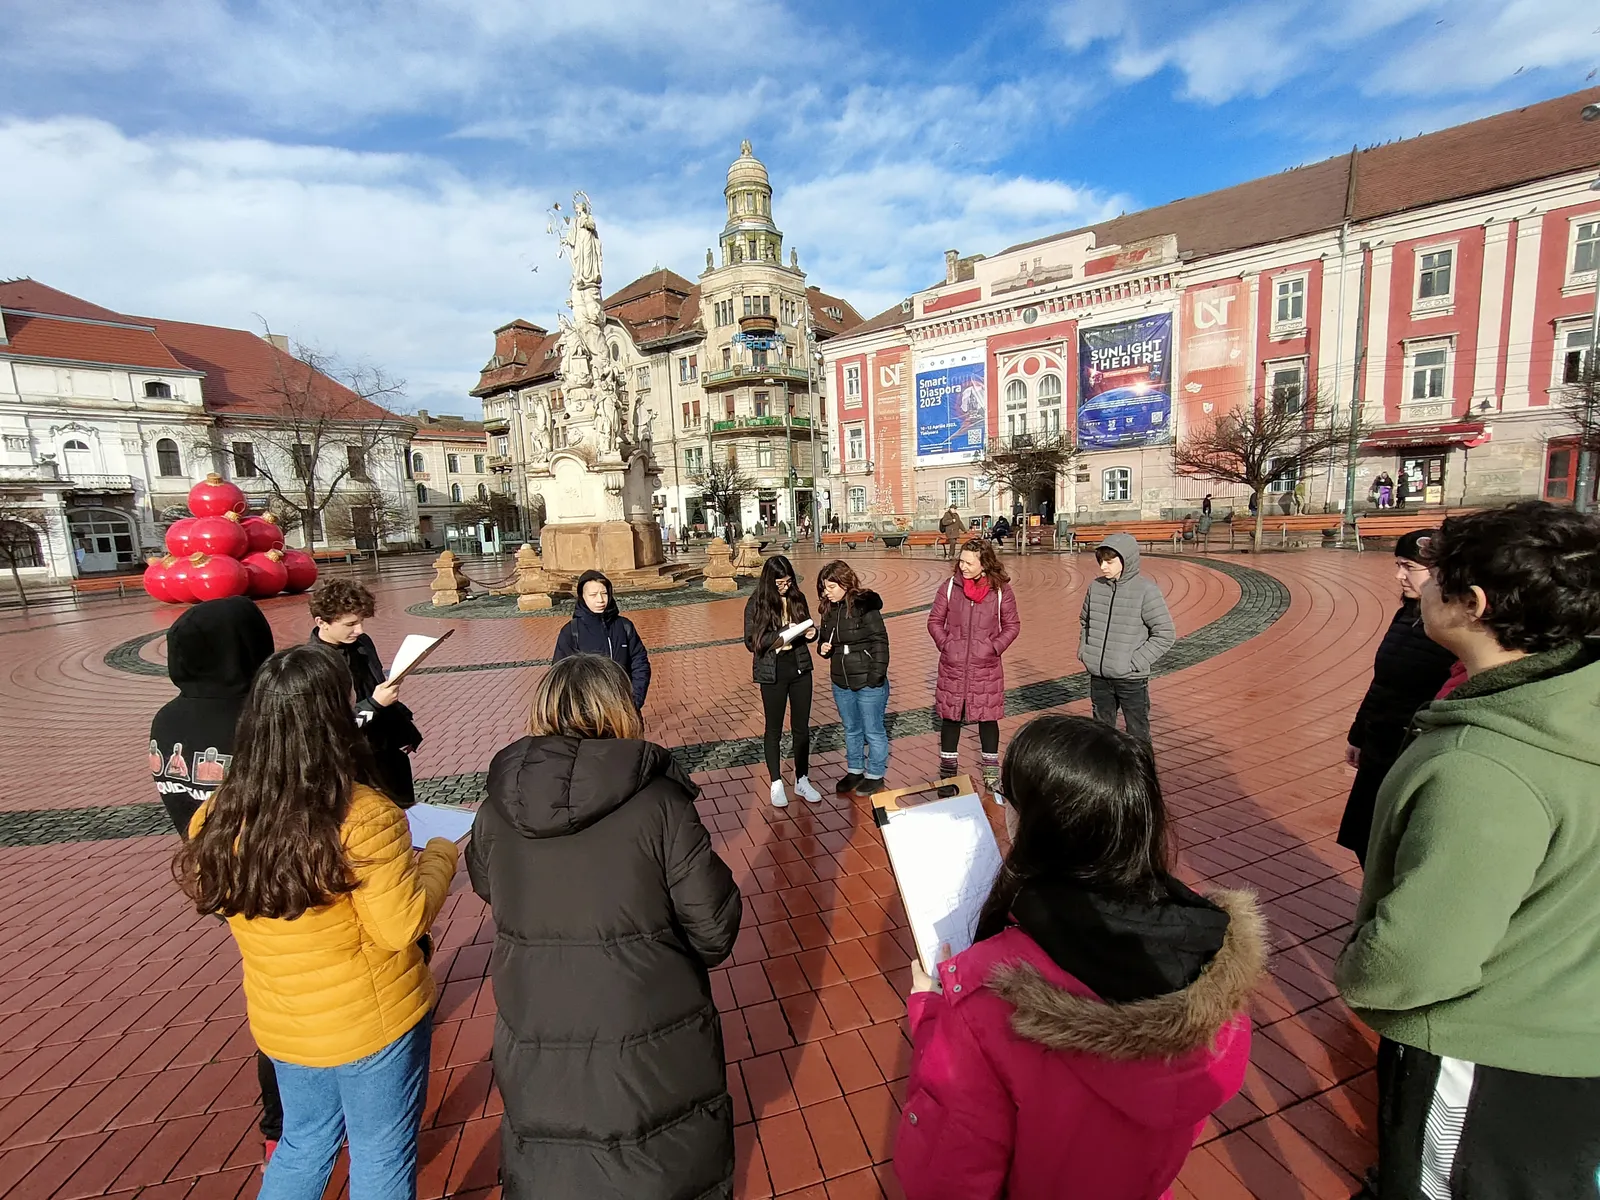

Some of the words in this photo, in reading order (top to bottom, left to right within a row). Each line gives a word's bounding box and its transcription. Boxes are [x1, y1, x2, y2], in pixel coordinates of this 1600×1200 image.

[1091, 339, 1162, 360] SUNLIGHT
[1091, 351, 1162, 371] THEATRE
[919, 375, 947, 389] Smart
[919, 385, 962, 399] Diaspora
[920, 397, 942, 409] 2023
[156, 781, 188, 794] QUID
